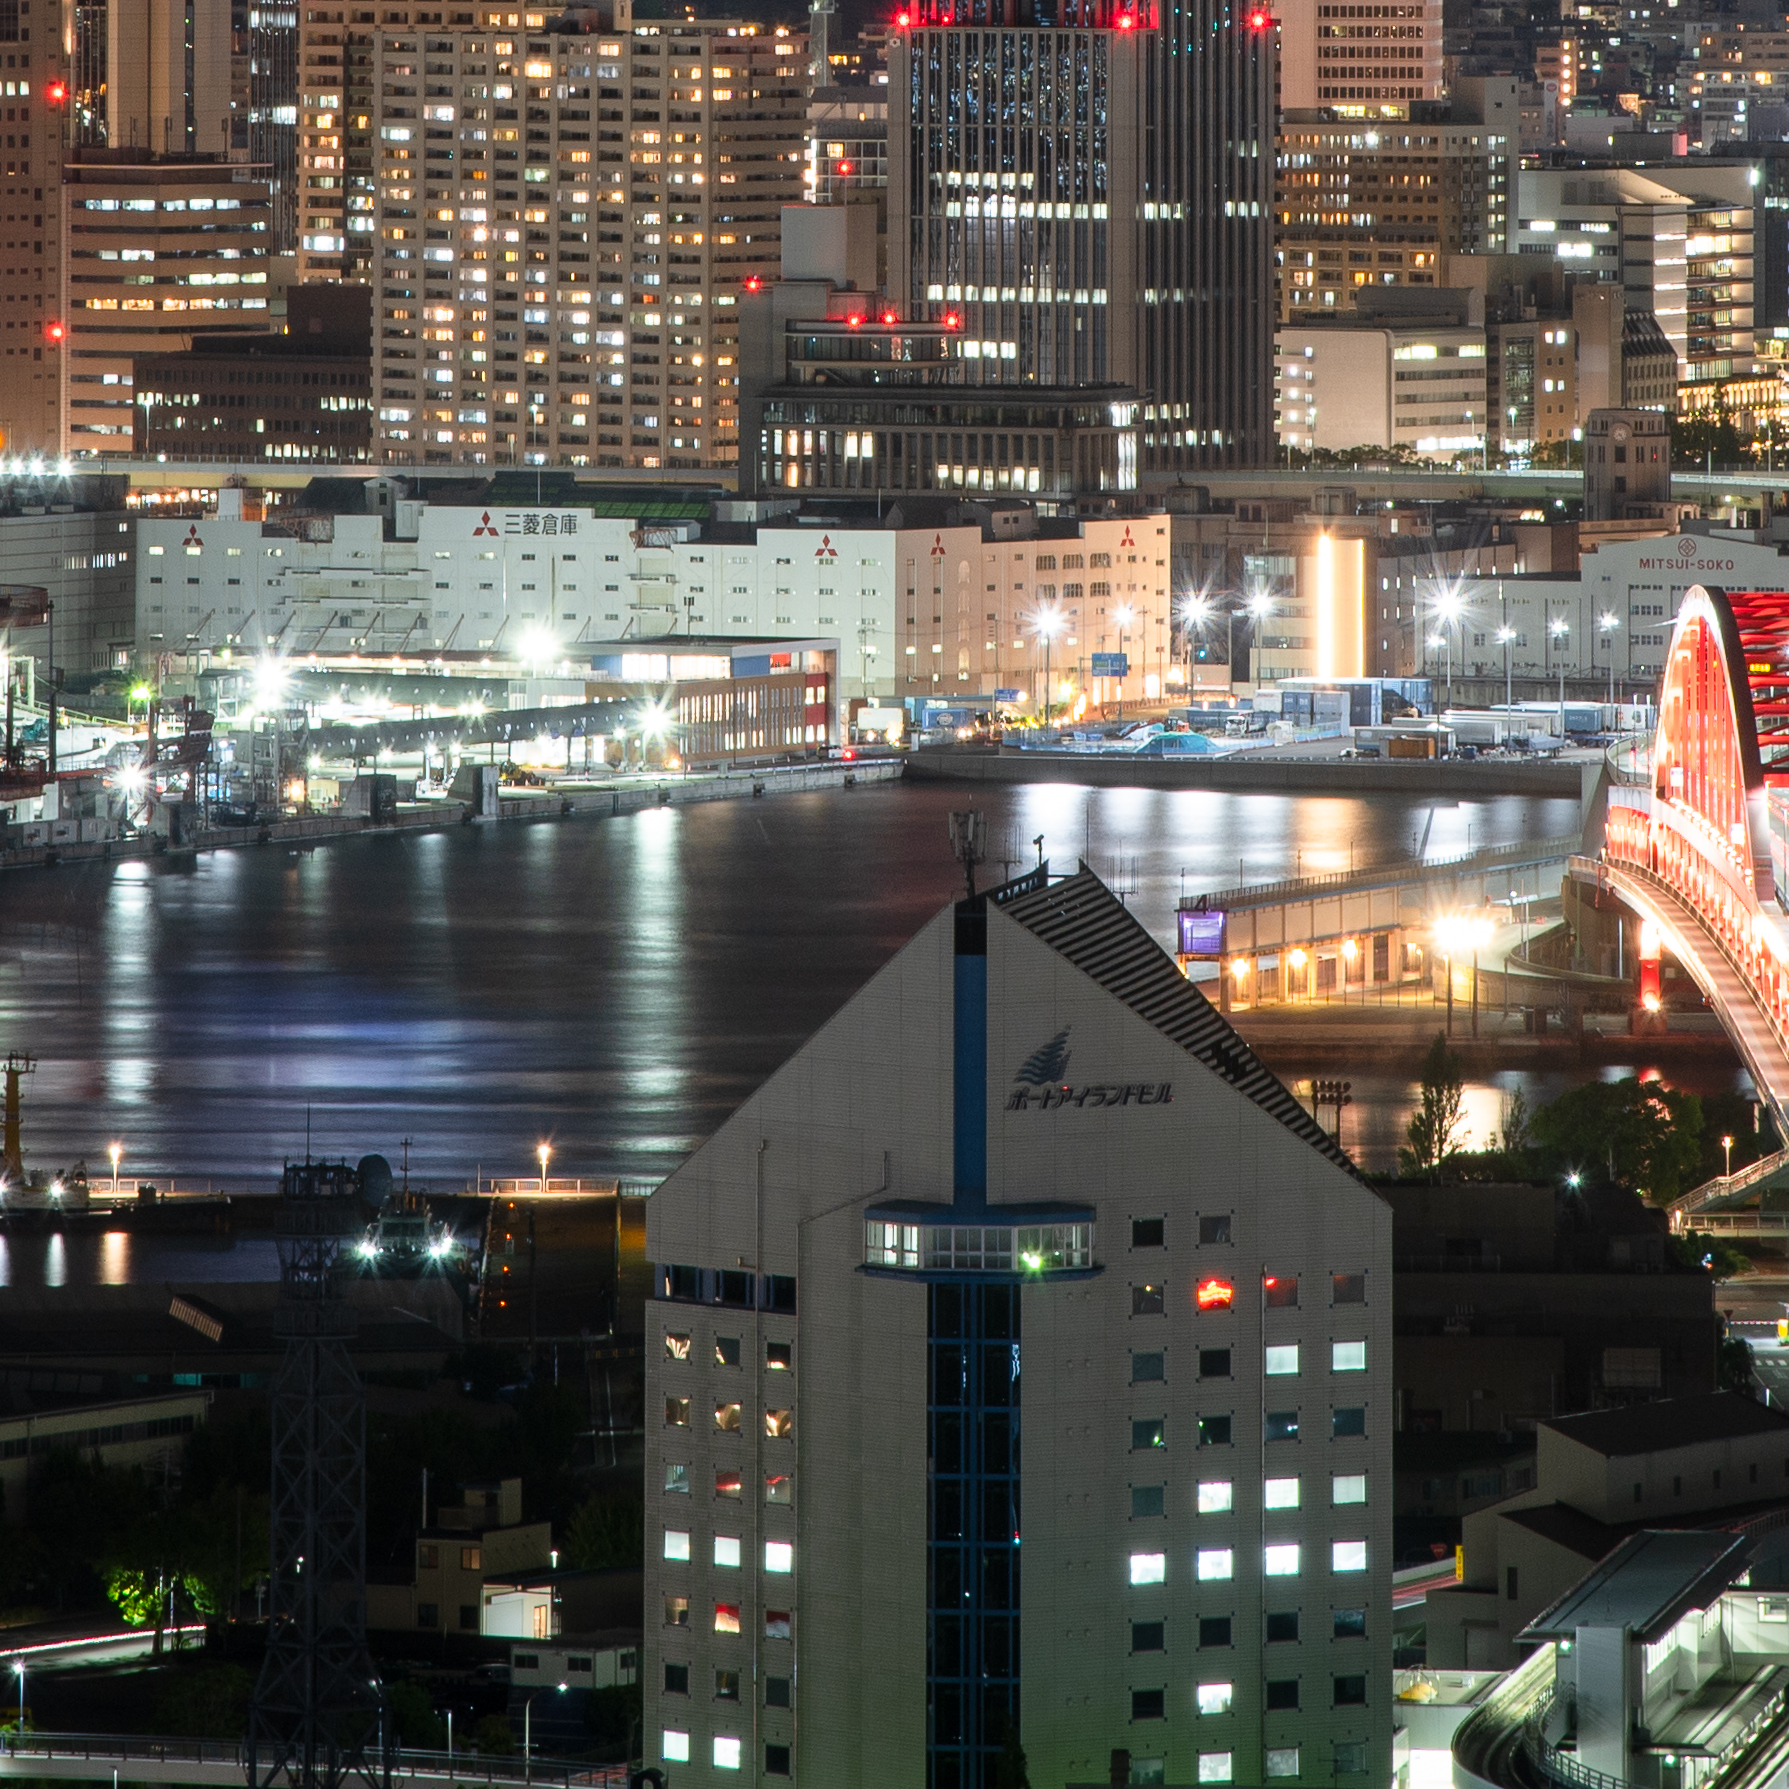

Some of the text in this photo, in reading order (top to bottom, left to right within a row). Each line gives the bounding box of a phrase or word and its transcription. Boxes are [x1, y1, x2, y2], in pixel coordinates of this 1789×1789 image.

[504, 513, 578, 536] 三菱倉庫
[1639, 558, 1734, 571] MITSUI-SOKO
[1194, 894, 1209, 915] 4
[1005, 1082, 1173, 1111] ポートアイランドビル
